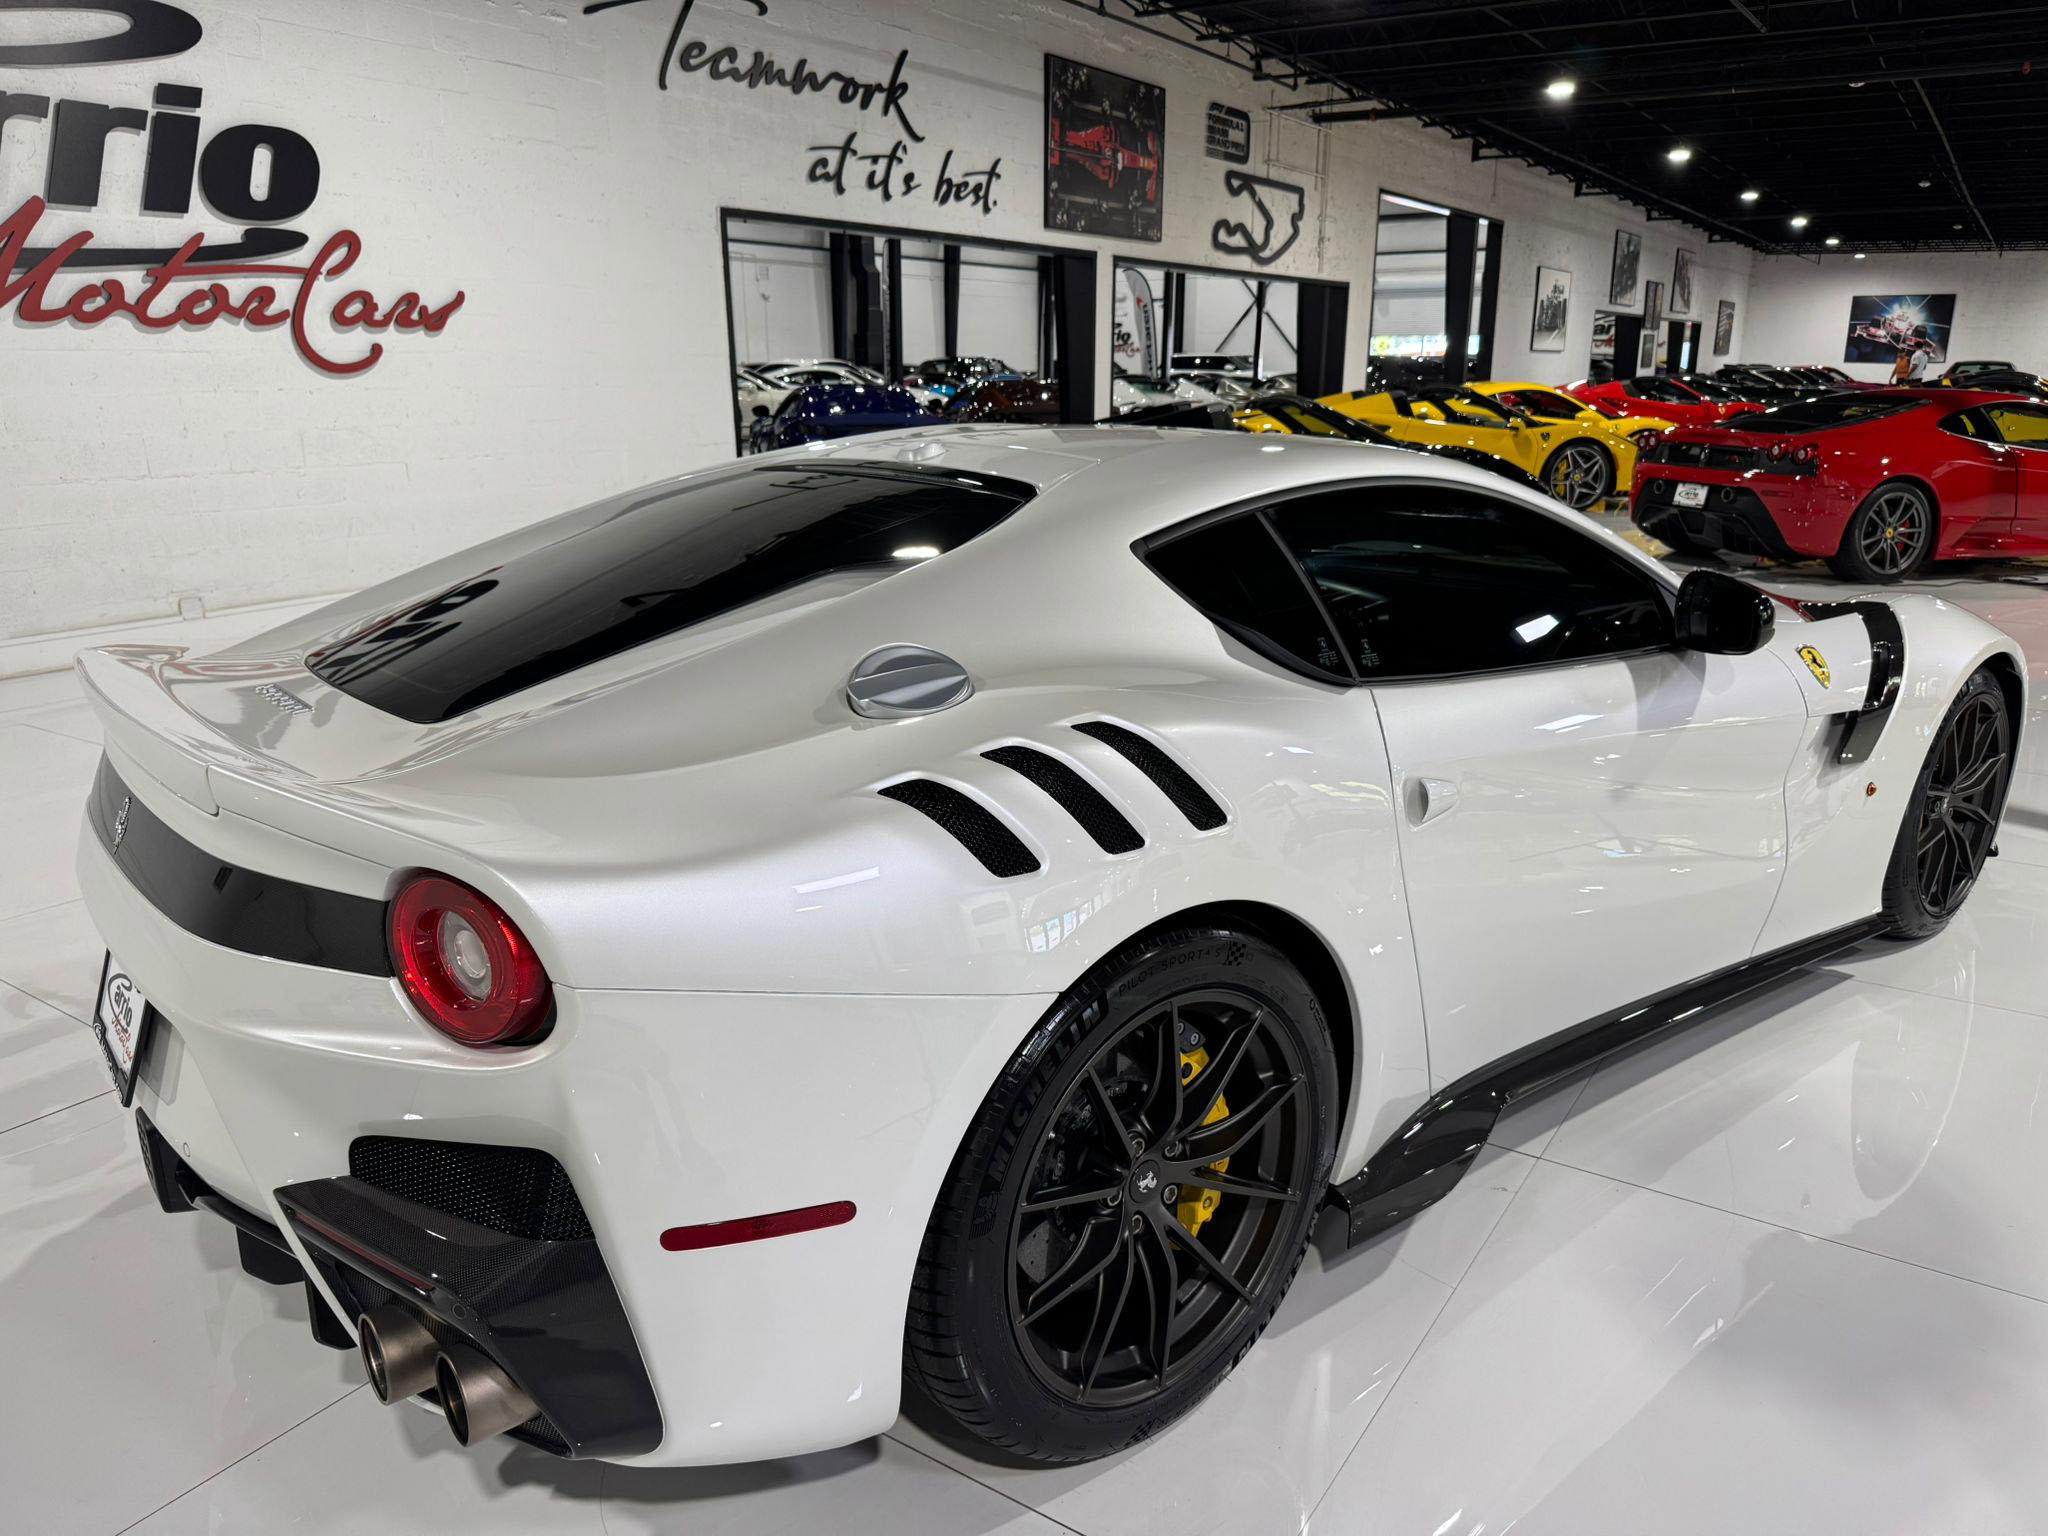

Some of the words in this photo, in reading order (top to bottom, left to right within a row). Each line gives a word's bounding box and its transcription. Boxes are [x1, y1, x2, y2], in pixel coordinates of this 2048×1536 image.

[583, 0, 925, 142] Teamwork
[806, 132, 857, 196] at
[857, 140, 921, 202] it's
[1118, 967, 1155, 997] PILOT
[1161, 949, 1204, 972] SPORT
[988, 999, 1104, 1184] MICHELIN
